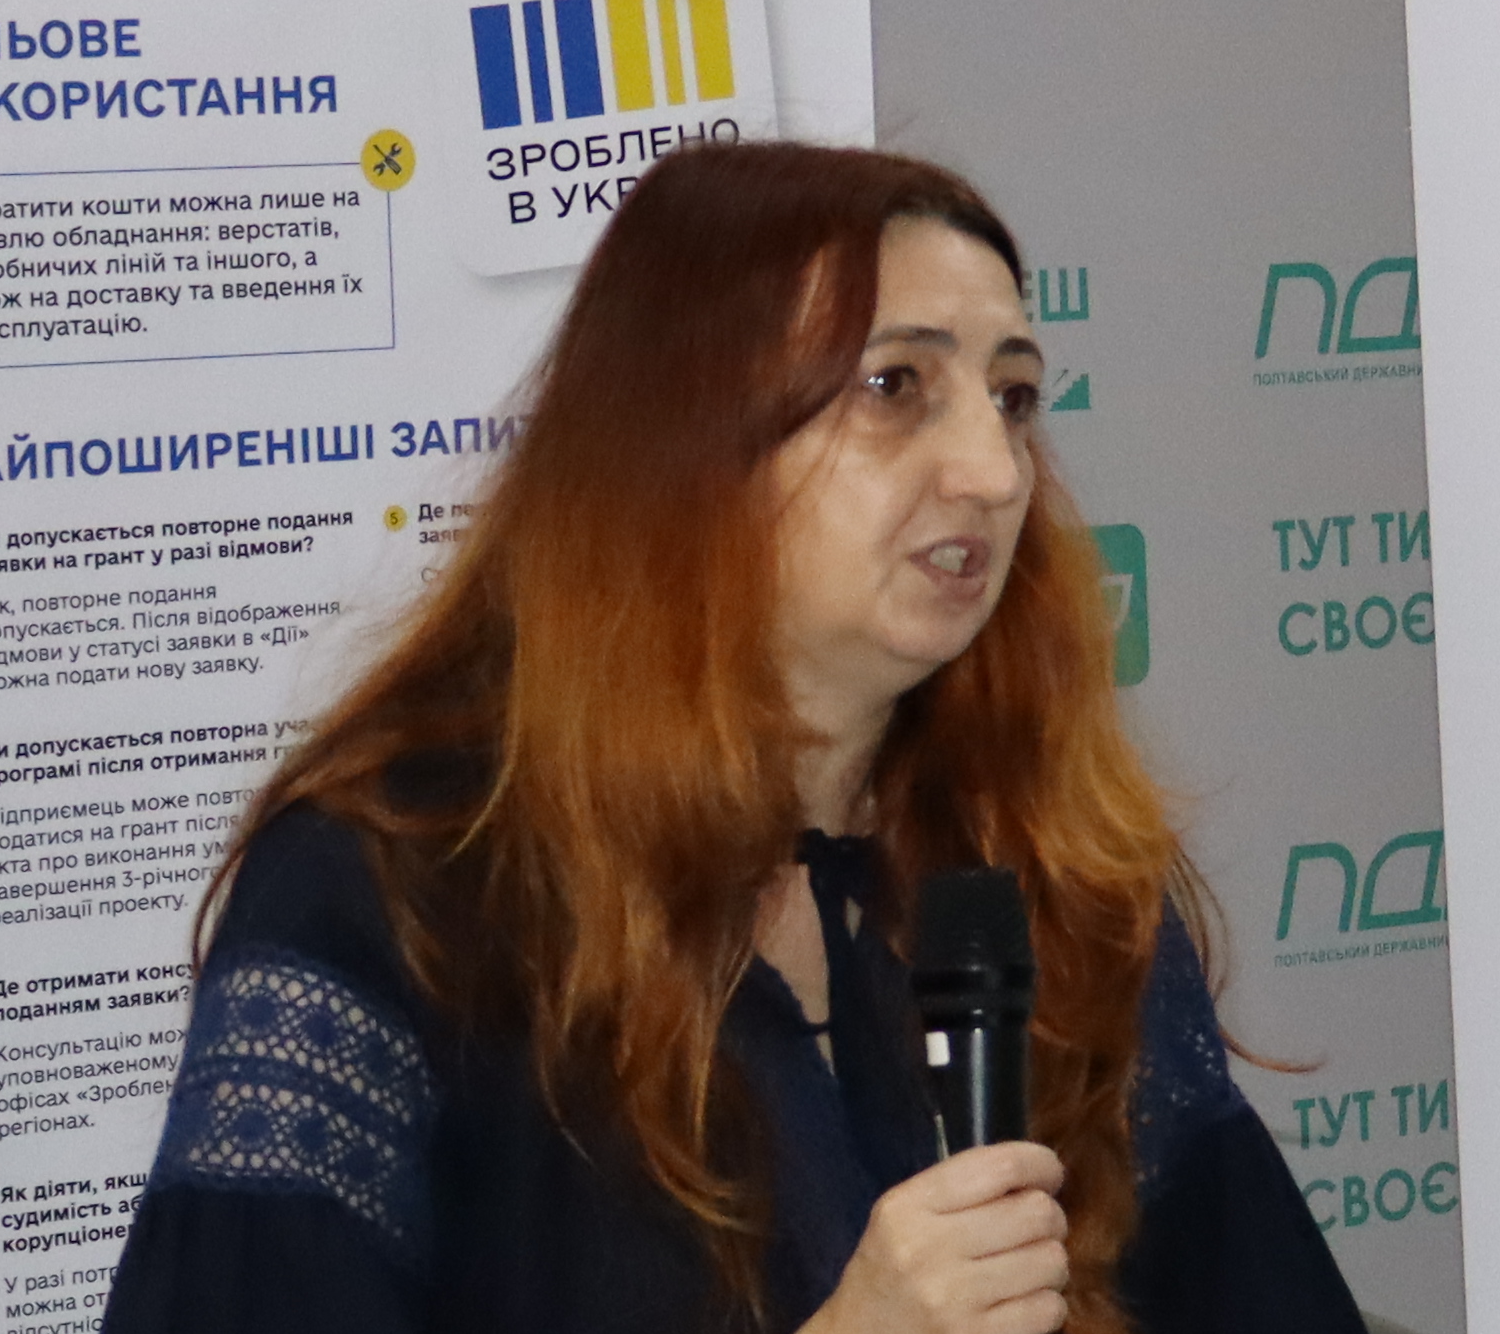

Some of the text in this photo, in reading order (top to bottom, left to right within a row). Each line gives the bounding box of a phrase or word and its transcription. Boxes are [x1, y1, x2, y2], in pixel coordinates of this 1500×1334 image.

[1272, 509, 1431, 572] ТУТ ТИ
[1277, 591, 1436, 657] СВОЄ
